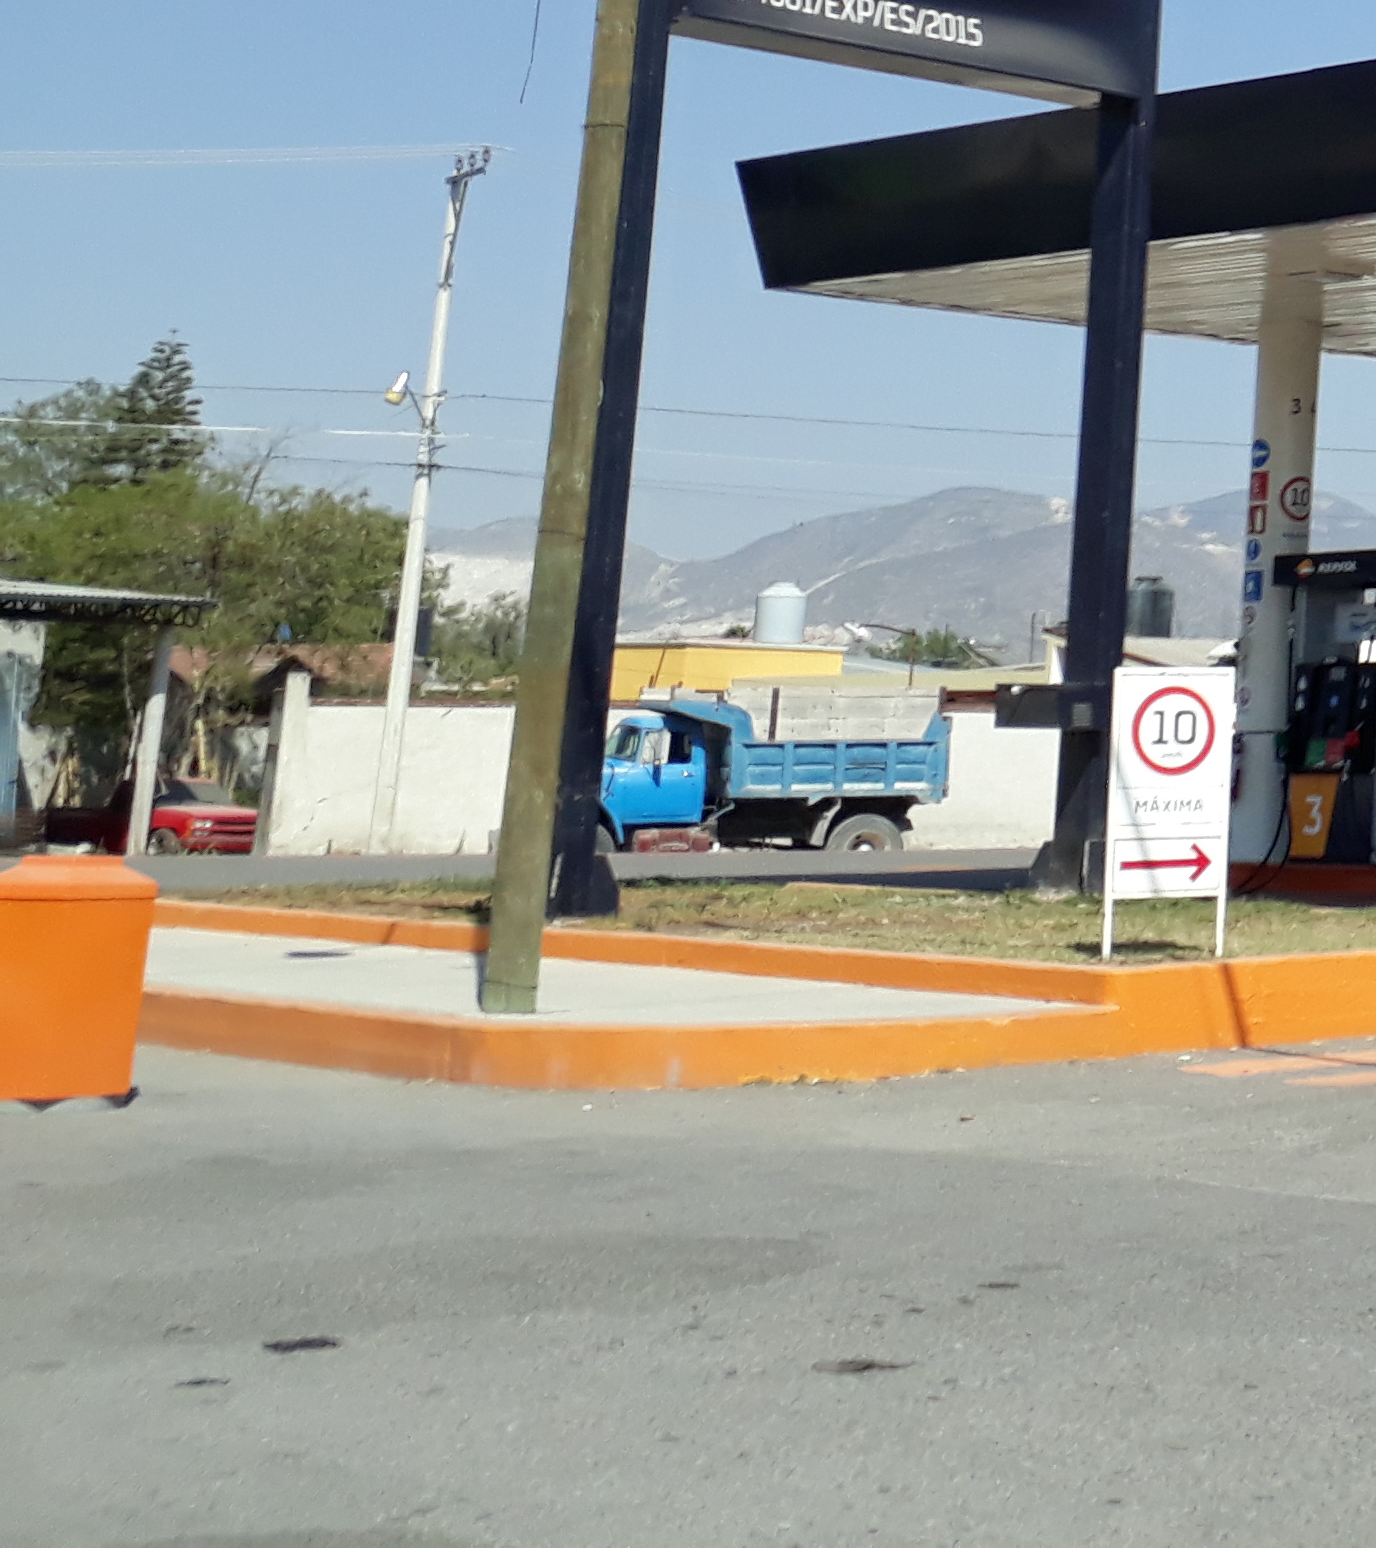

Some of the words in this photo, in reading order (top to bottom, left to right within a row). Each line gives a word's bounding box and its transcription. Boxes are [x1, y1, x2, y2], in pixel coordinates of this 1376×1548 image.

[1291, 398, 1301, 415] 3
[1151, 710, 1197, 745] 10
[1135, 796, 1203, 814] MÁXIMA
[1302, 794, 1323, 836] 3
